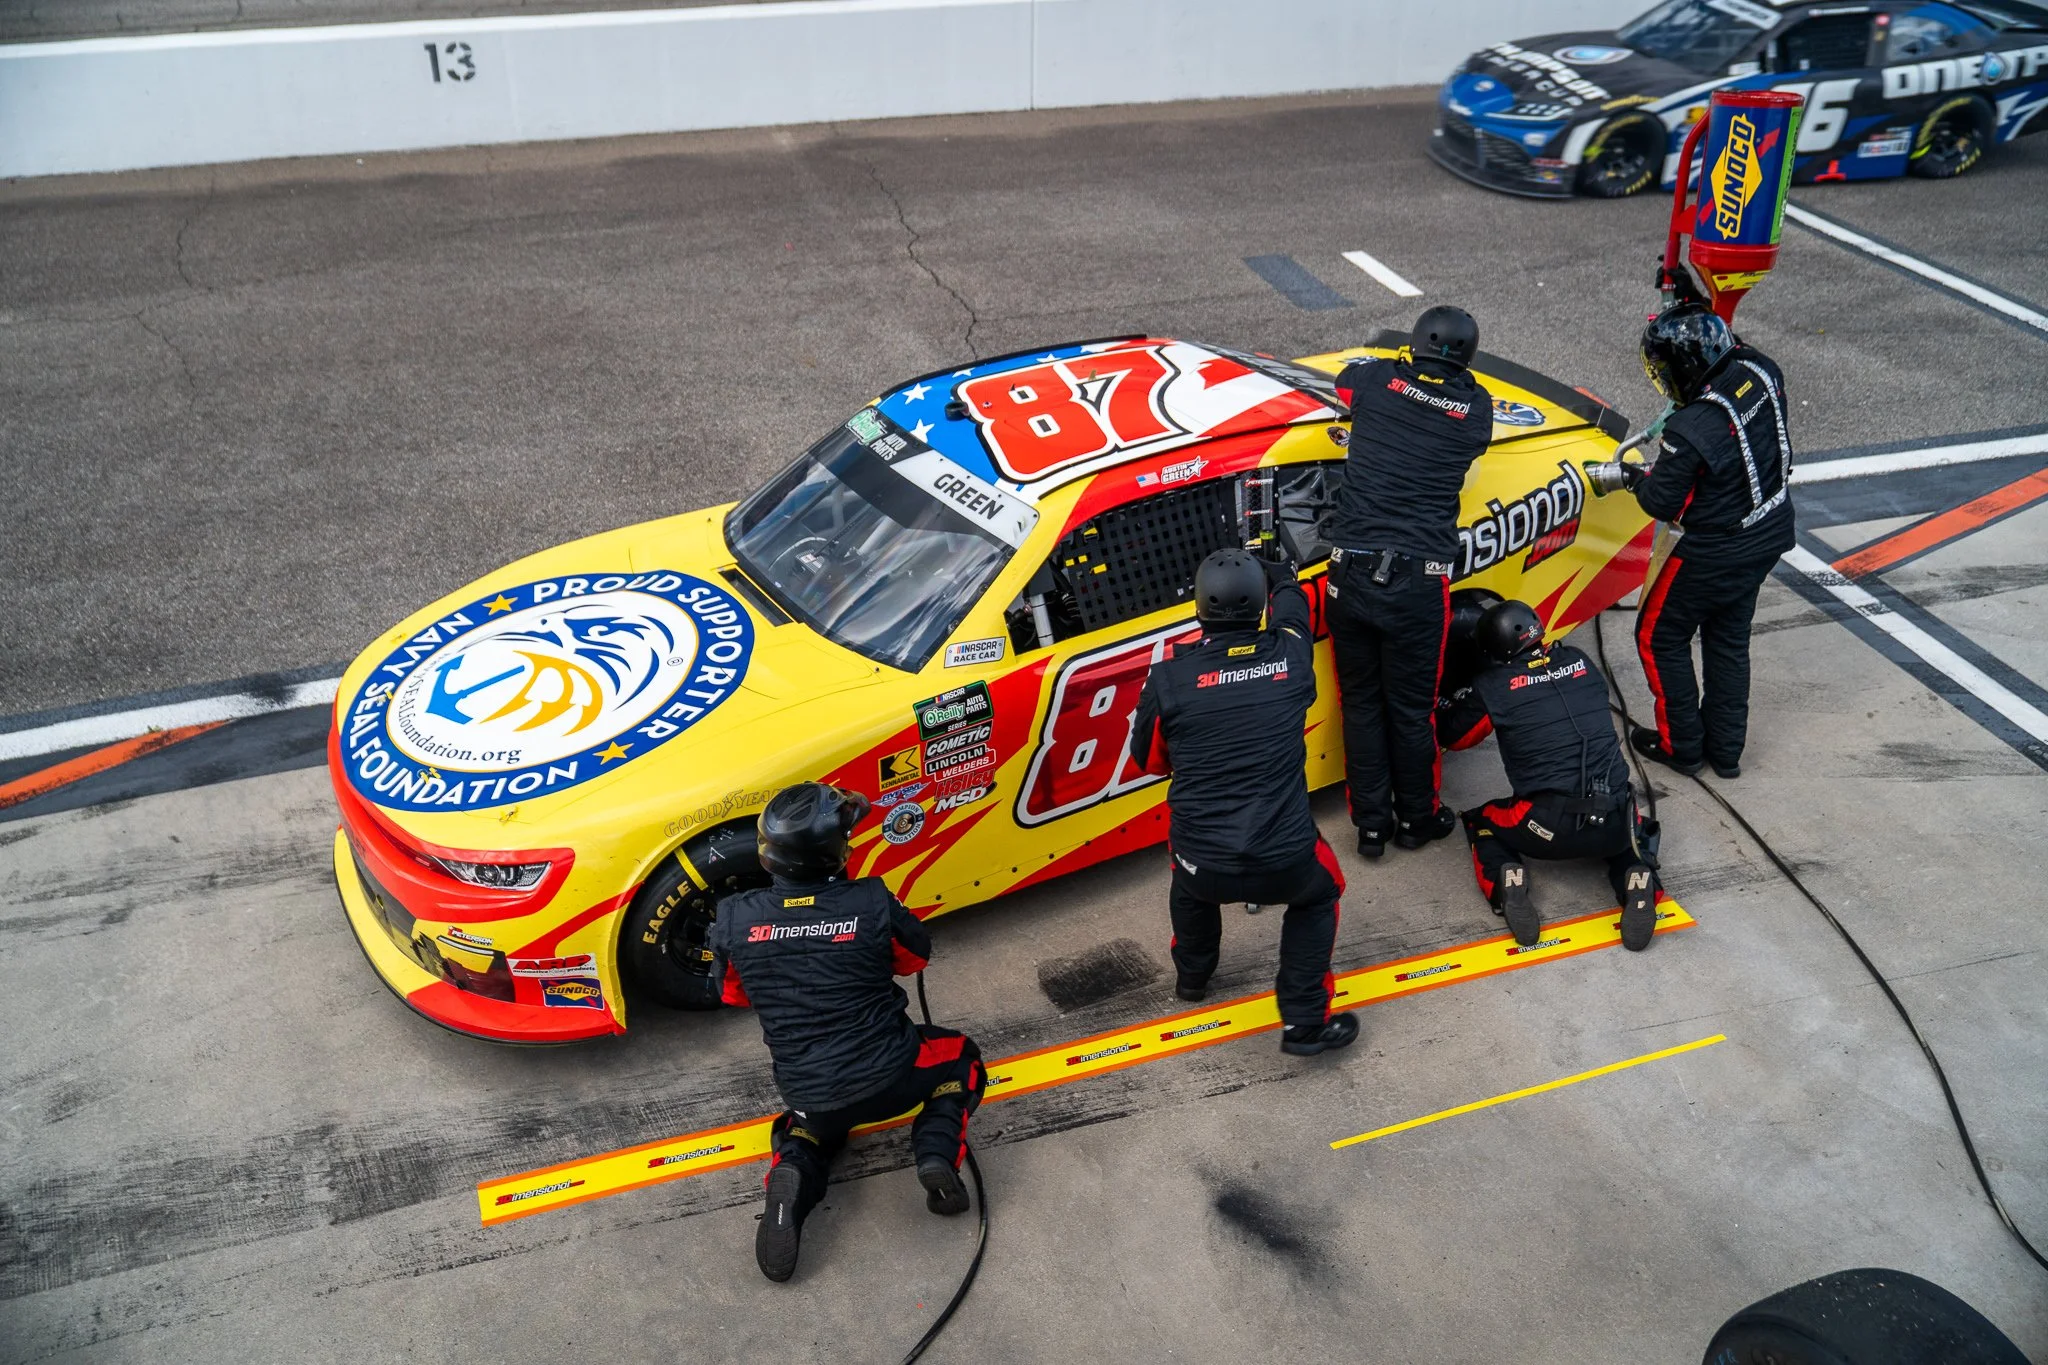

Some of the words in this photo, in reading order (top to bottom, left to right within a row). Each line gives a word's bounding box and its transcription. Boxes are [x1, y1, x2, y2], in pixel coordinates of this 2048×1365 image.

[424, 42, 476, 82] 13
[1719, 118, 1752, 235] SUNOCO
[961, 346, 1176, 477] 87
[870, 439, 897, 461] PARTS
[883, 433, 907, 451] AUTO
[1162, 469, 1193, 483] GREEN
[933, 473, 1005, 520] GREEN
[1448, 463, 1583, 580] nsional
[1527, 518, 1578, 566] .com
[533, 570, 682, 603] PROUD
[381, 612, 474, 674] NAVY
[965, 640, 998, 653] NASCAR
[637, 585, 744, 740] SUPPORTER
[953, 653, 977, 663] RACE
[978, 651, 996, 660] CAR
[1197, 657, 1288, 688] 3Dimensional
[942, 687, 966, 702] NASCAR
[965, 701, 988, 715] PARTS
[349, 681, 395, 750] SEAL
[924, 703, 965, 728] O'Reilly
[966, 694, 984, 707] AUTO
[947, 720, 968, 733] SERIES
[926, 725, 991, 758] COMETIC
[928, 746, 984, 773] LINCOLN
[942, 756, 990, 778] WELDERS
[352, 742, 579, 806] FOUNDATION
[881, 771, 921, 789] KENNAMETAL
[934, 768, 996, 800] Holley
[886, 803, 921, 823] CHAMPION
[933, 787, 988, 814] MSD
[886, 822, 922, 843] IRRIGATION
[642, 880, 692, 944] EAGLE
[747, 916, 859, 942] 3Dimensional
[513, 955, 592, 970] ARP
[548, 986, 598, 997] SUNOCO
